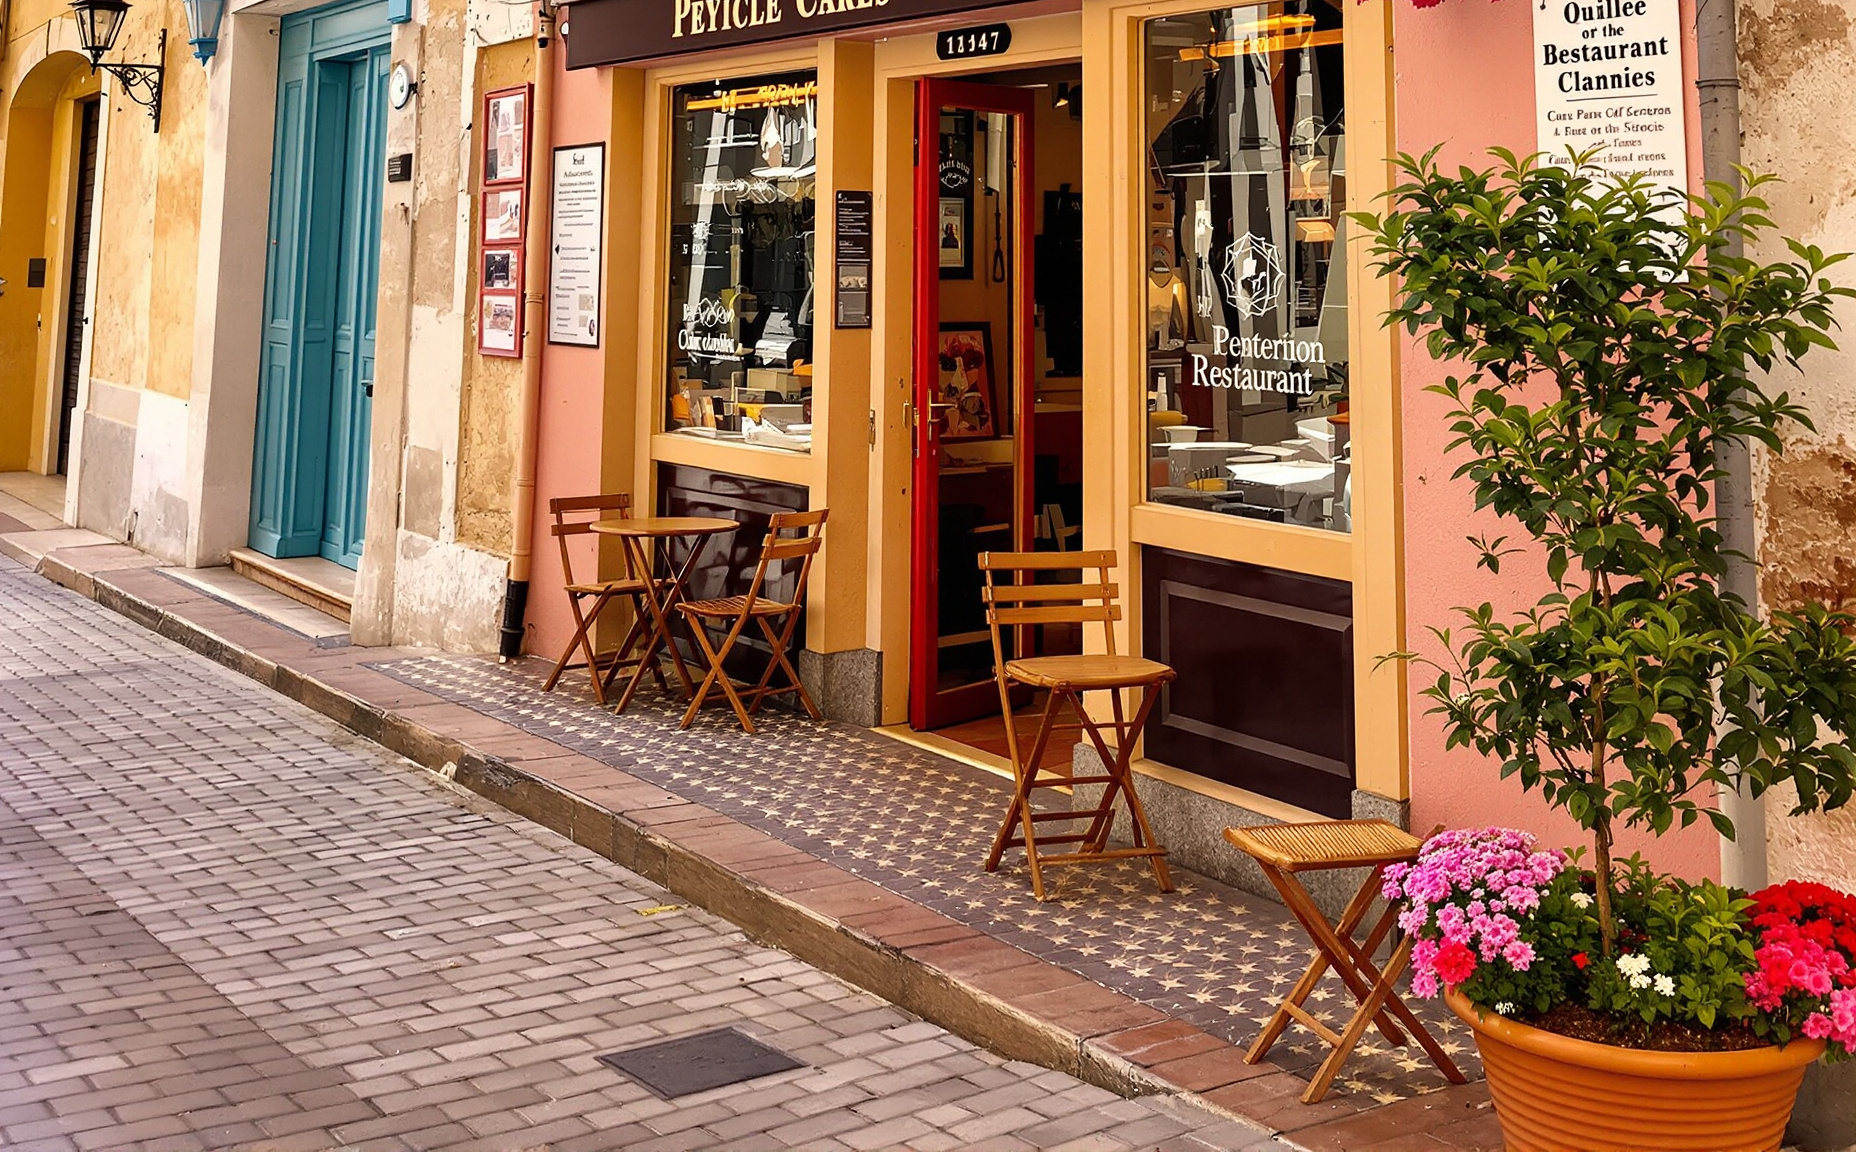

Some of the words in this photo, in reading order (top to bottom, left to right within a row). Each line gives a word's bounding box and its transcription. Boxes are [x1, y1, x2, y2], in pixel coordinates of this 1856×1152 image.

[1581, 27, 1598, 39] or
[1602, 23, 1625, 38] the
[1542, 36, 1670, 66] Bestaurant
[1557, 66, 1656, 93] Clannies
[1190, 353, 1314, 396] Restaurant
